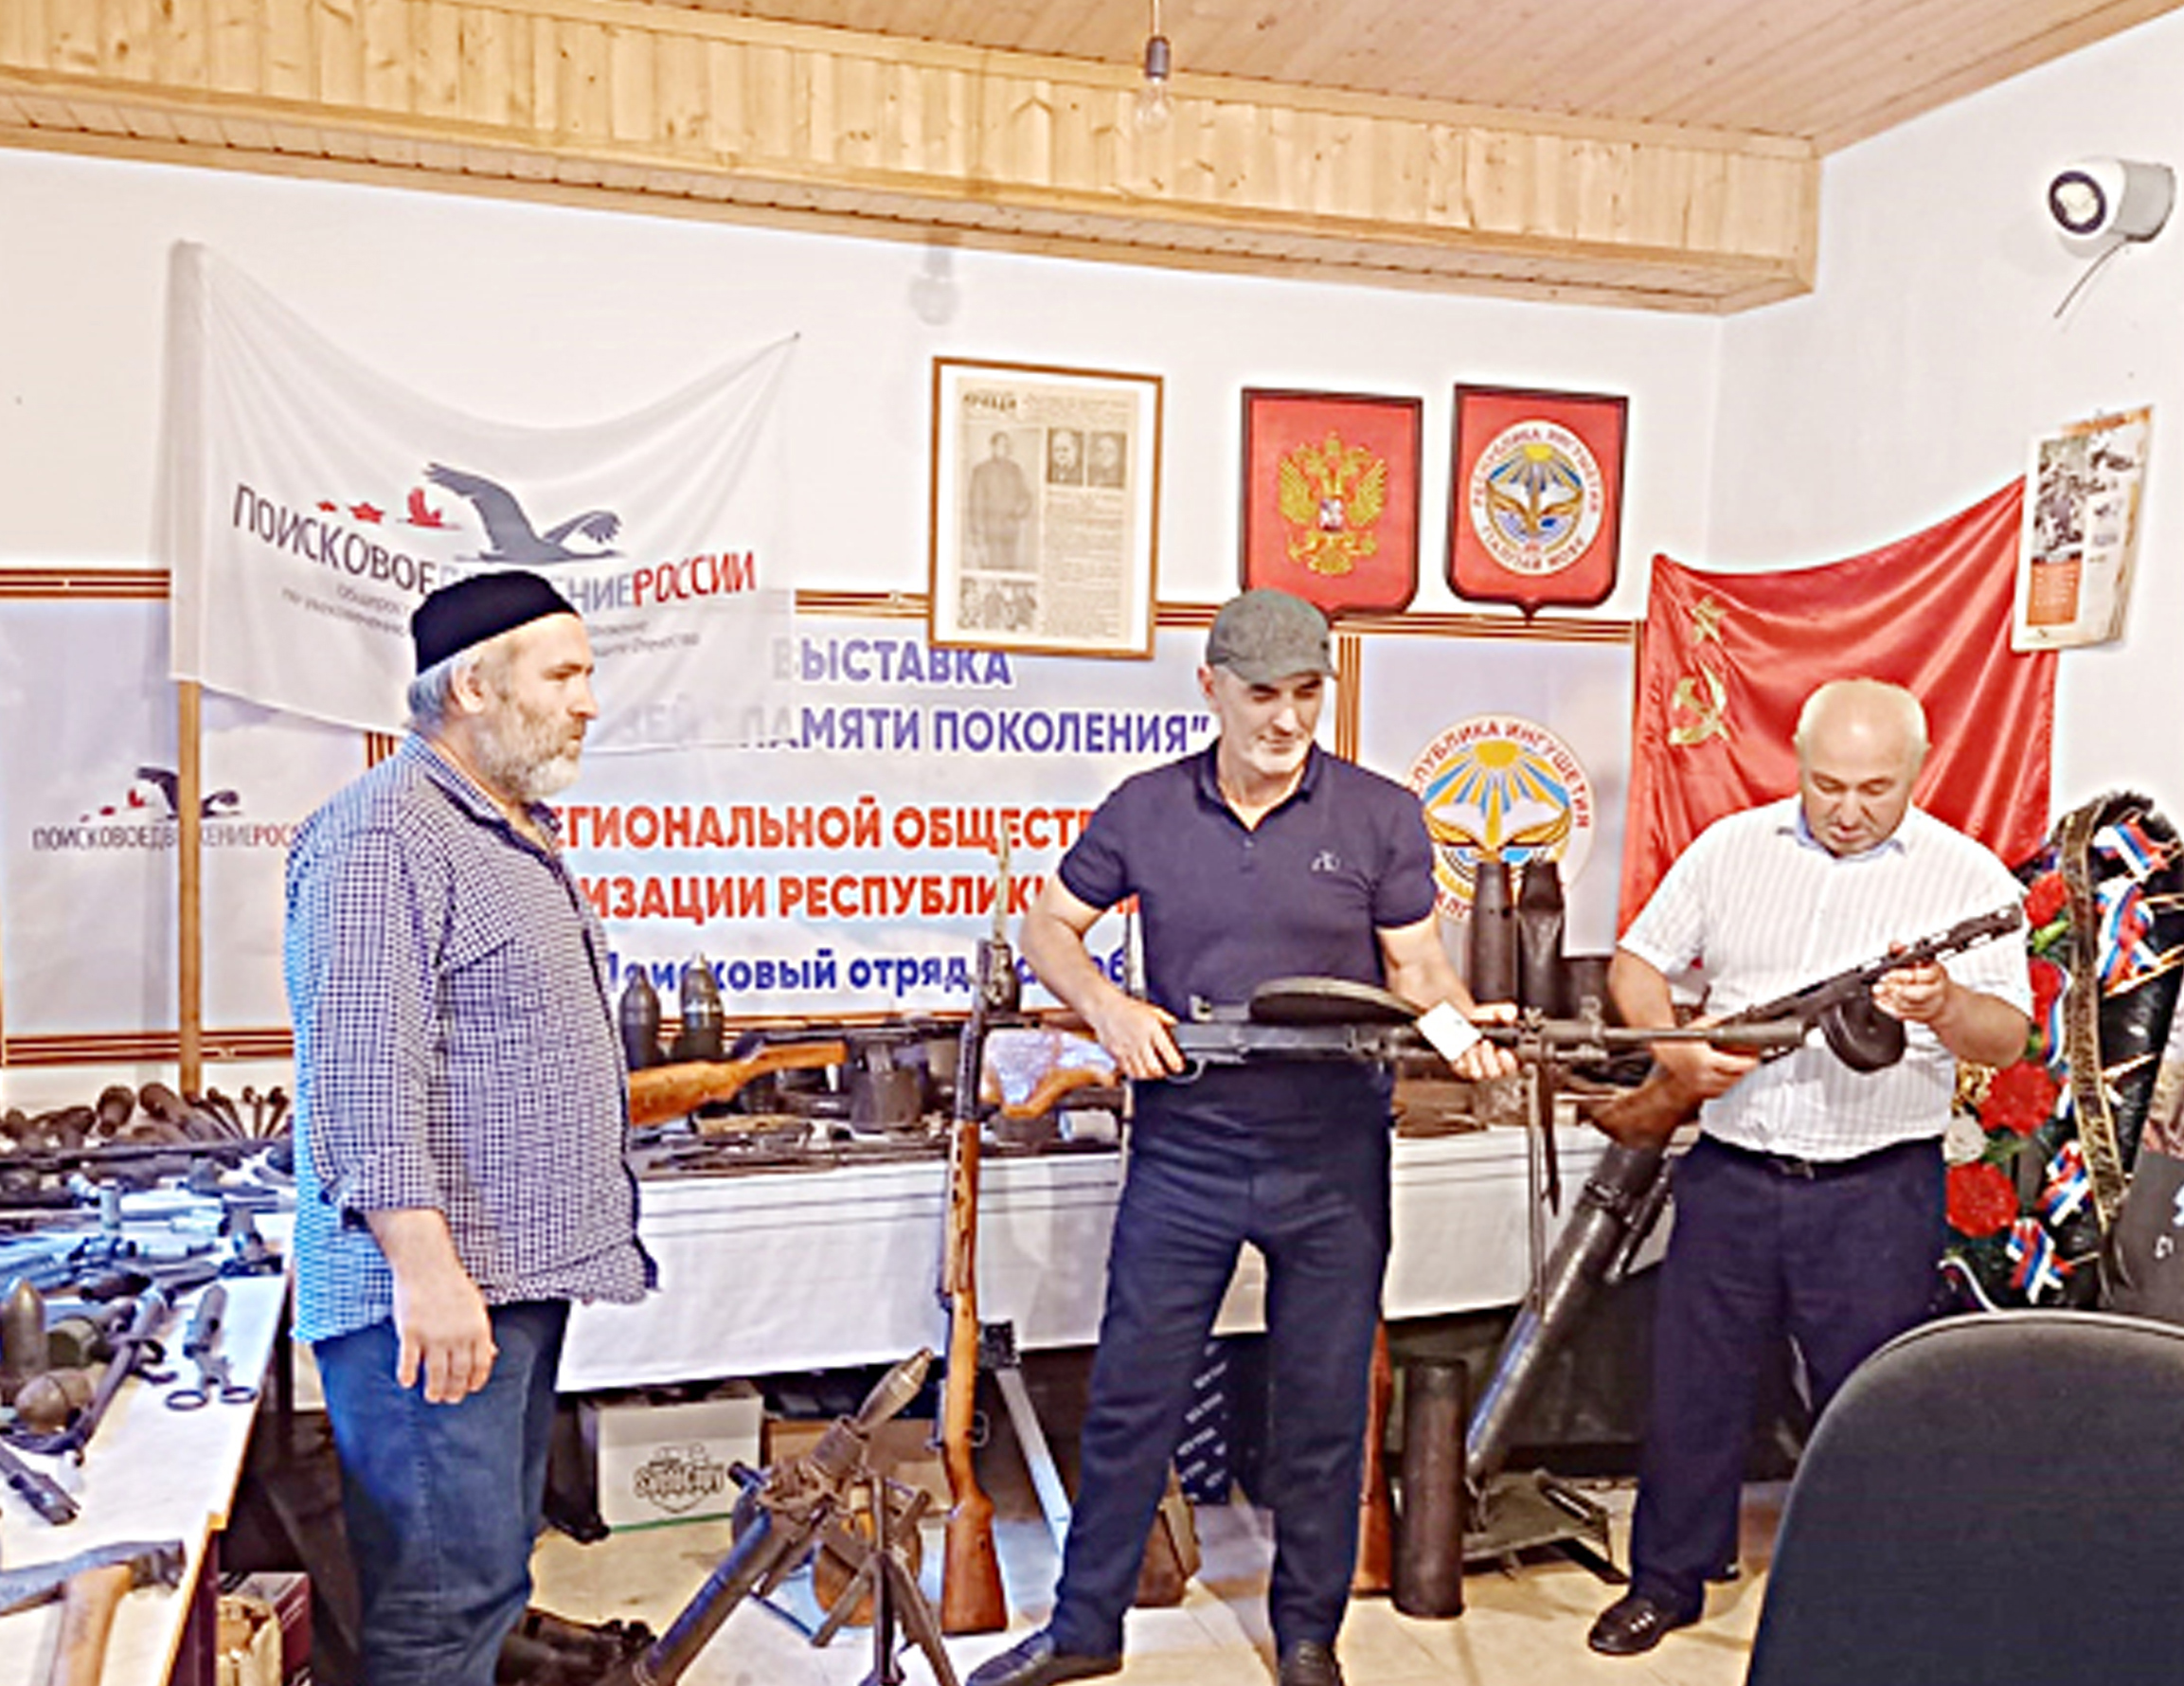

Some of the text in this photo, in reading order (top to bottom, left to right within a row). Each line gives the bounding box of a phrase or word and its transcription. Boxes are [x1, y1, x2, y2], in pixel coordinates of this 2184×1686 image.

[772, 638, 1011, 684] ВЫСТАВКА
[934, 710, 1210, 753] ПОКОЛЕНИЯ"
[555, 796, 1095, 855] ГИОНАЛЬНОЙ ОБЩЕСТ
[580, 875, 1045, 925] ИЗАЦИИ РЕСПУБЛИК
[848, 957, 970, 998] отряд
